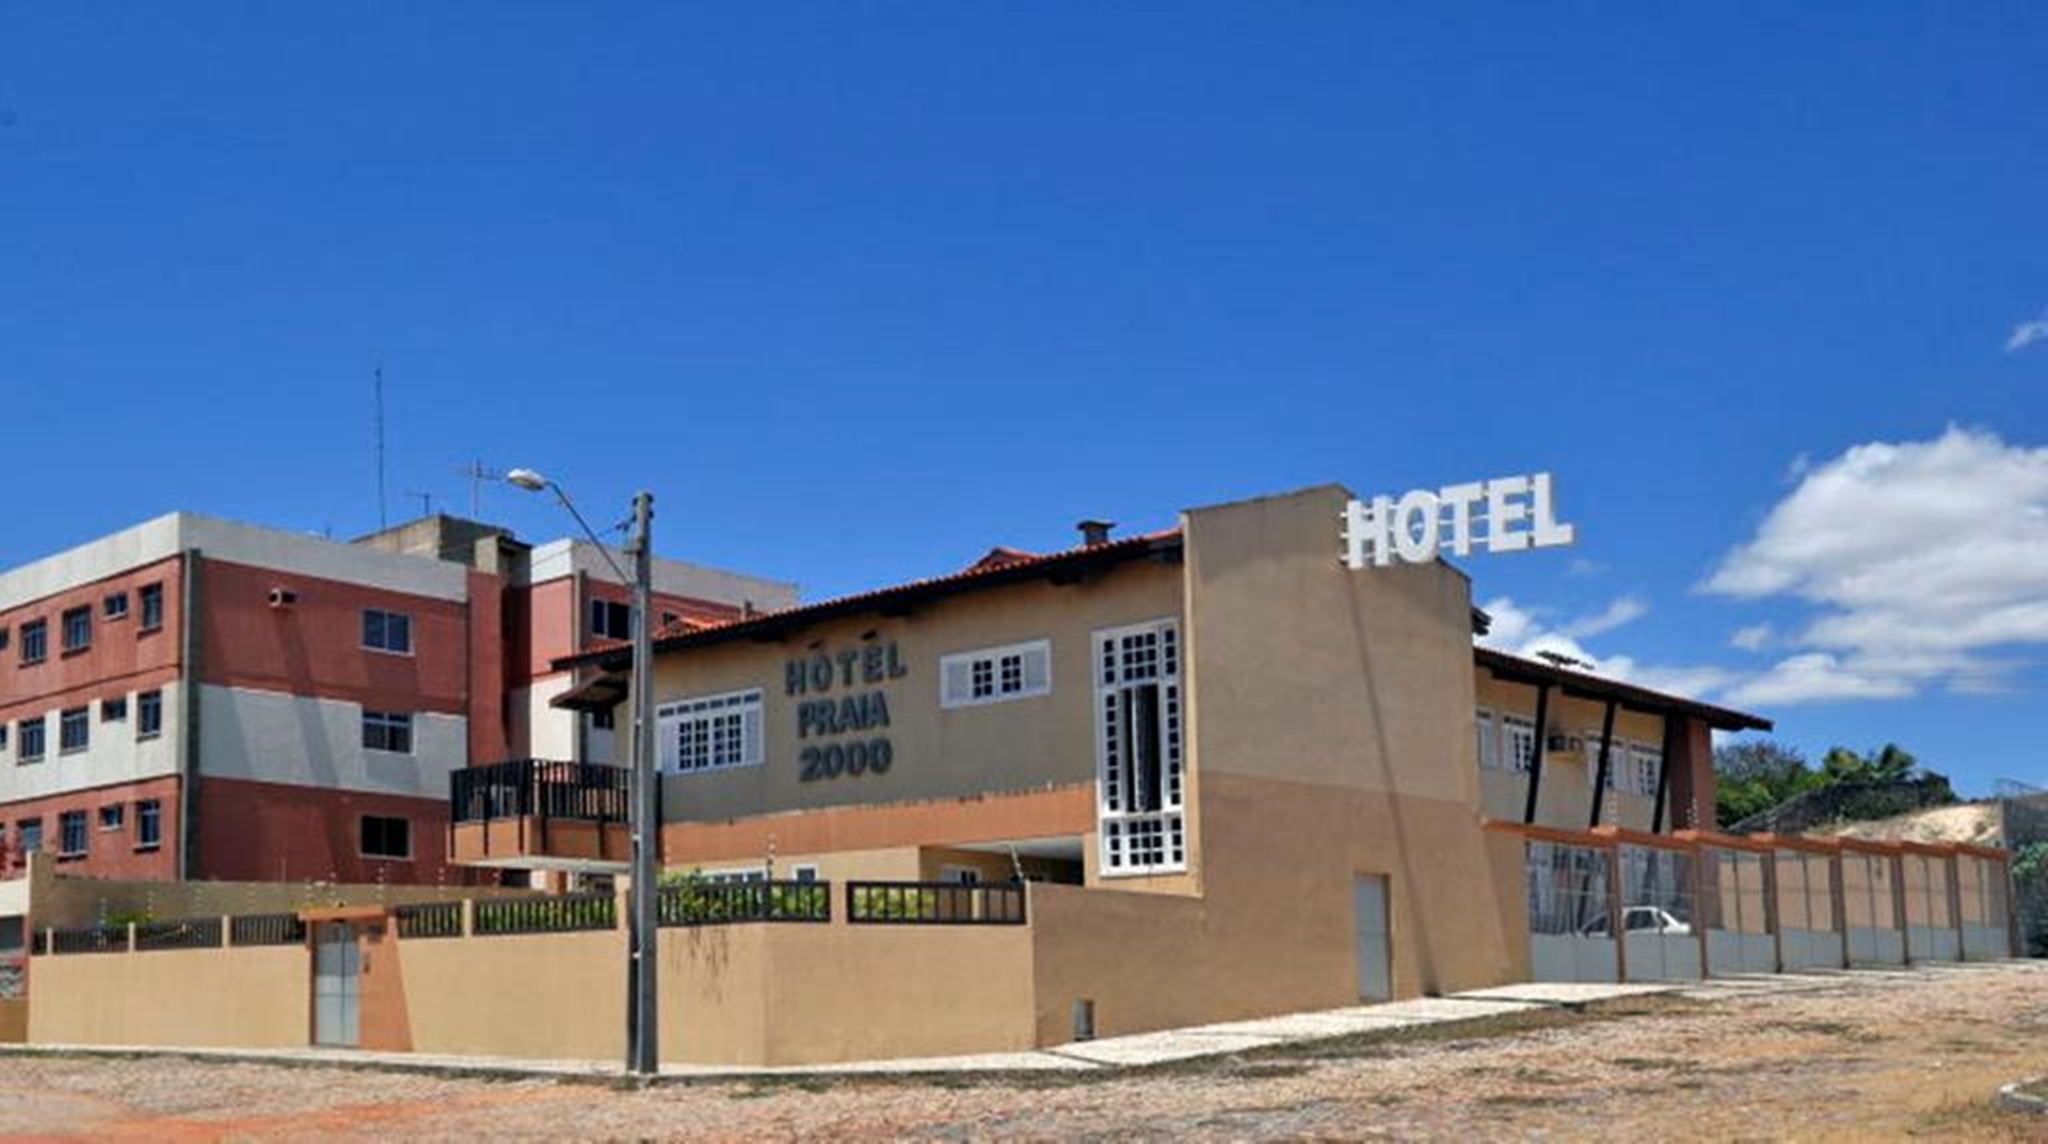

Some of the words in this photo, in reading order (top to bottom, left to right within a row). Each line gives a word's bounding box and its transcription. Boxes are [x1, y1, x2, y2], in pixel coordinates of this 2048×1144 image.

[1347, 472, 1574, 569] HOTEL
[798, 690, 890, 738] PRAIA
[798, 737, 893, 783] 2000
